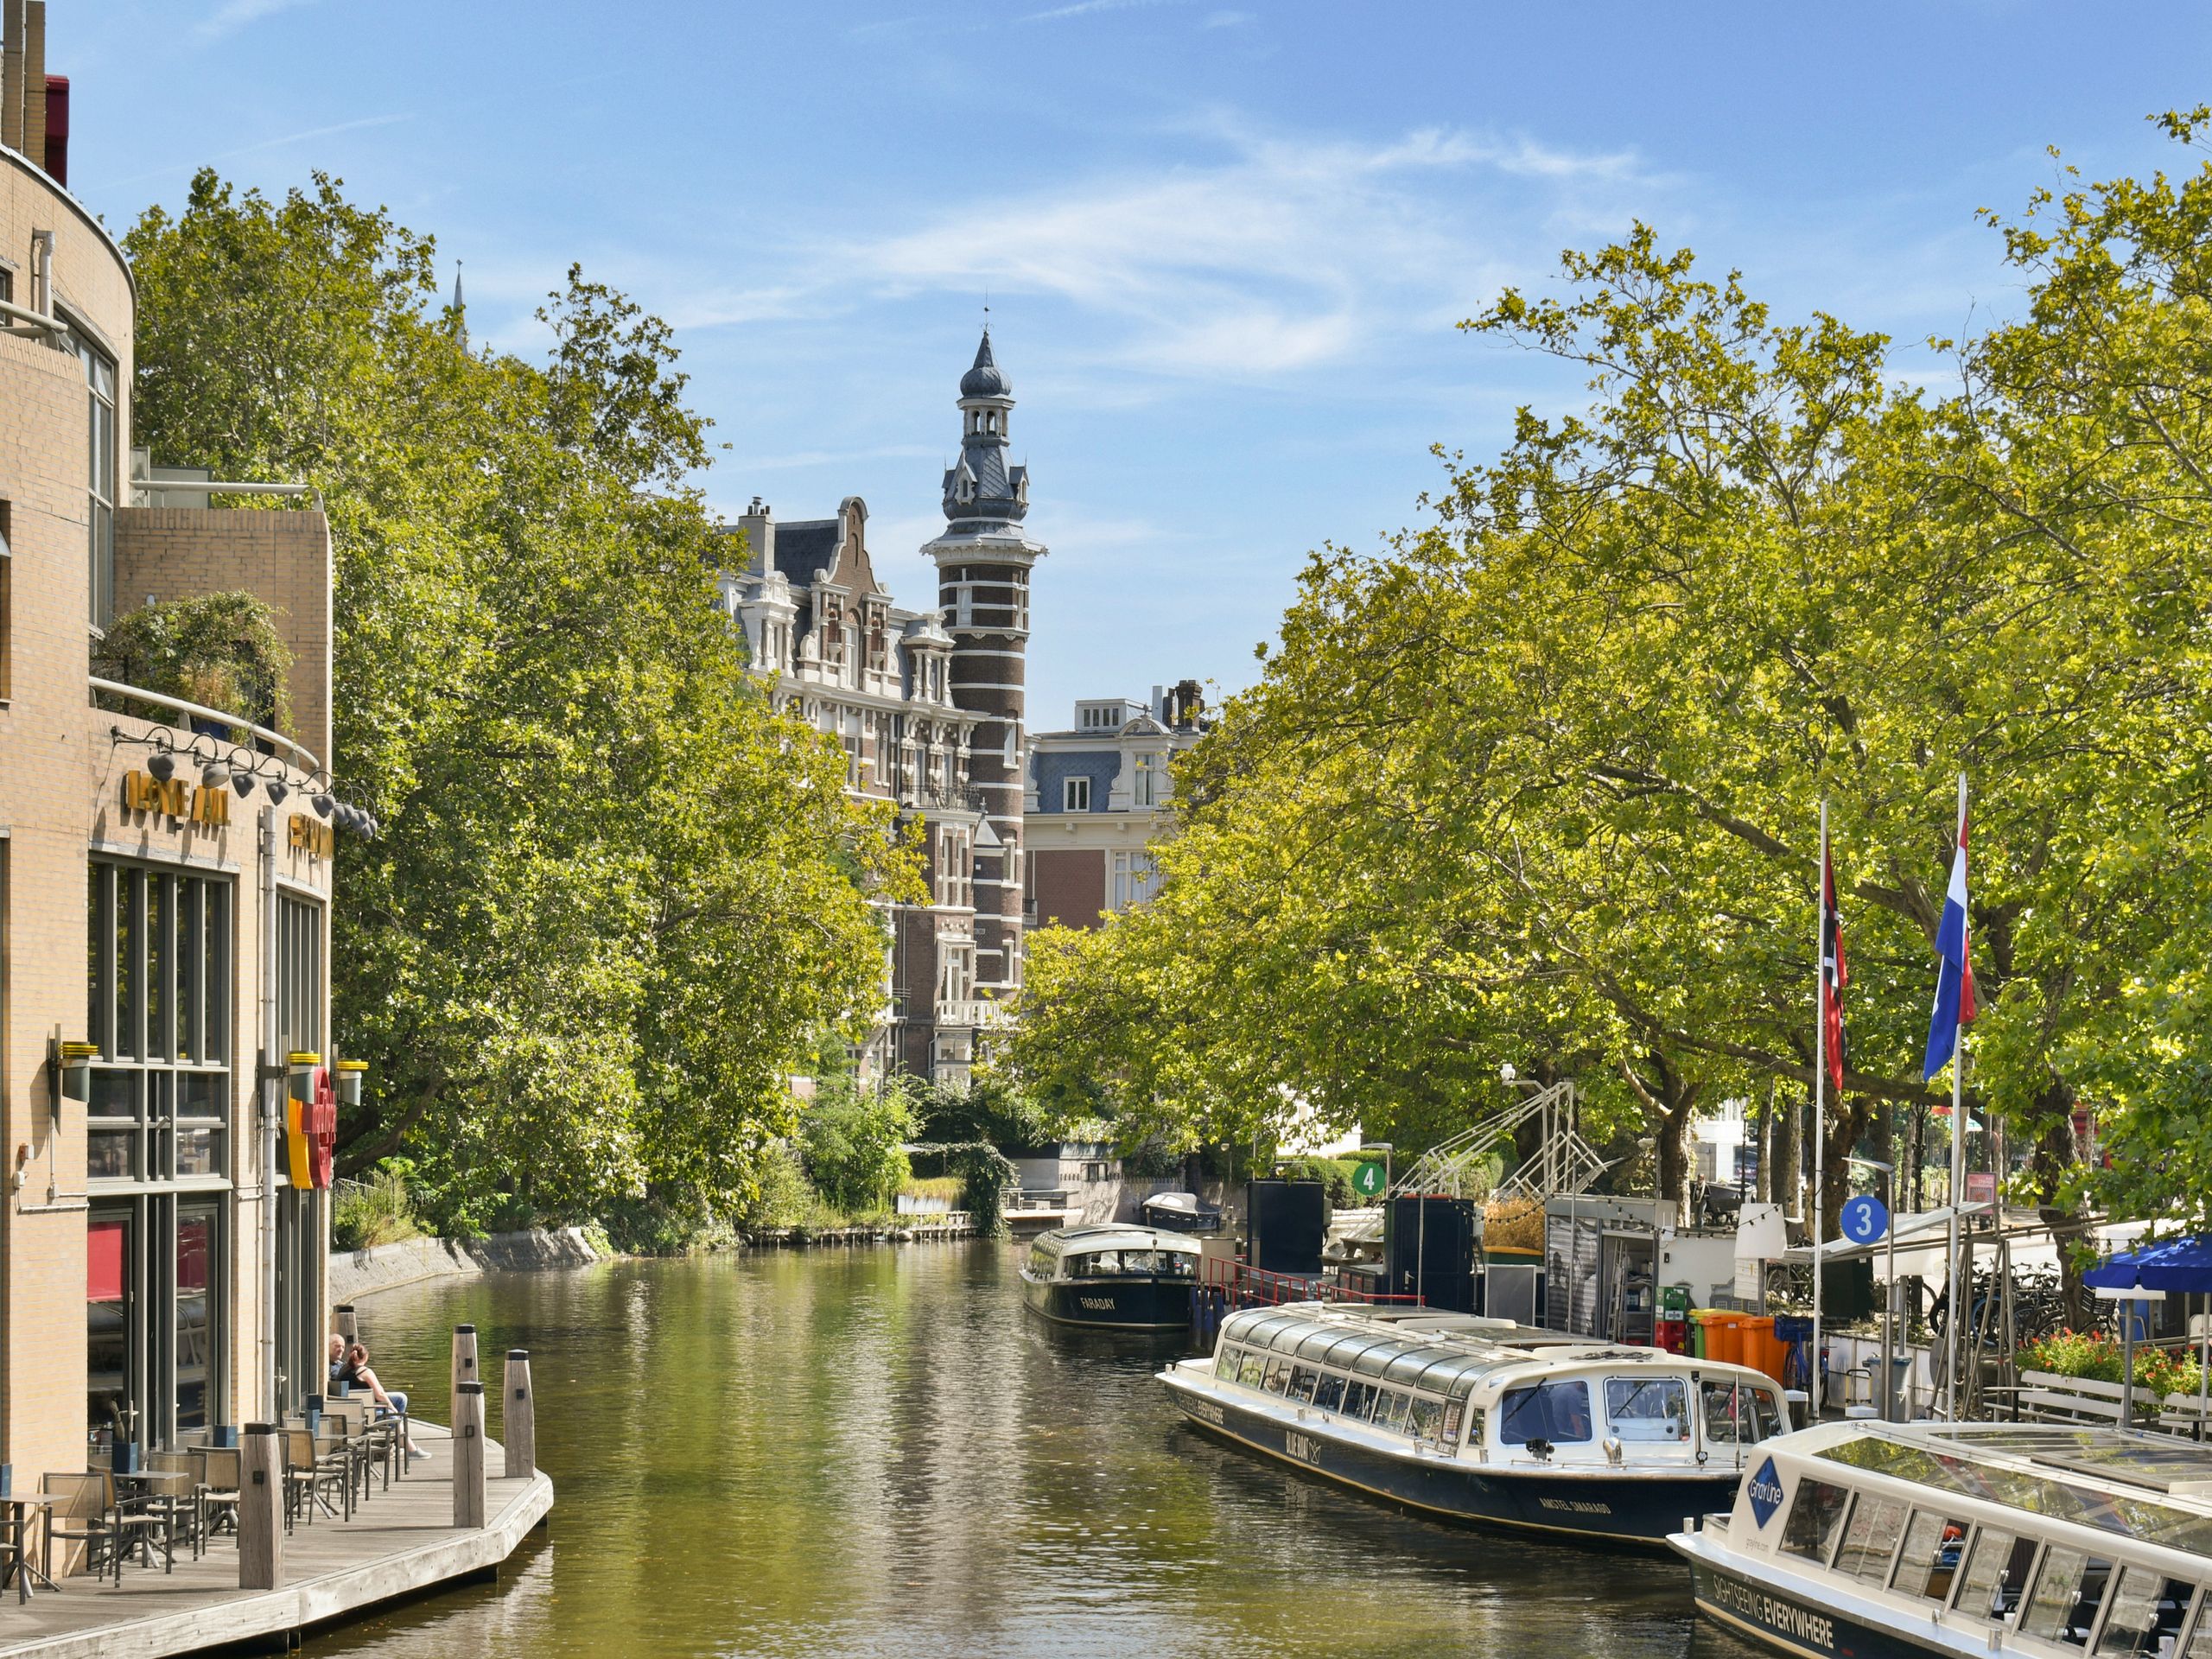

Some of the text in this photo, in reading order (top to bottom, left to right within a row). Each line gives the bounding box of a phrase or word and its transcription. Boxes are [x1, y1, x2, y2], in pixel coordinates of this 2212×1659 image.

[1363, 1167, 1375, 1191] 4
[1856, 1203, 1872, 1236] 3
[1080, 1297, 1116, 1310] FARADAY
[1538, 1497, 1573, 1511] AMSTEL
[1713, 1574, 1834, 1649] SIGHTSEEING EVERYWHERE
